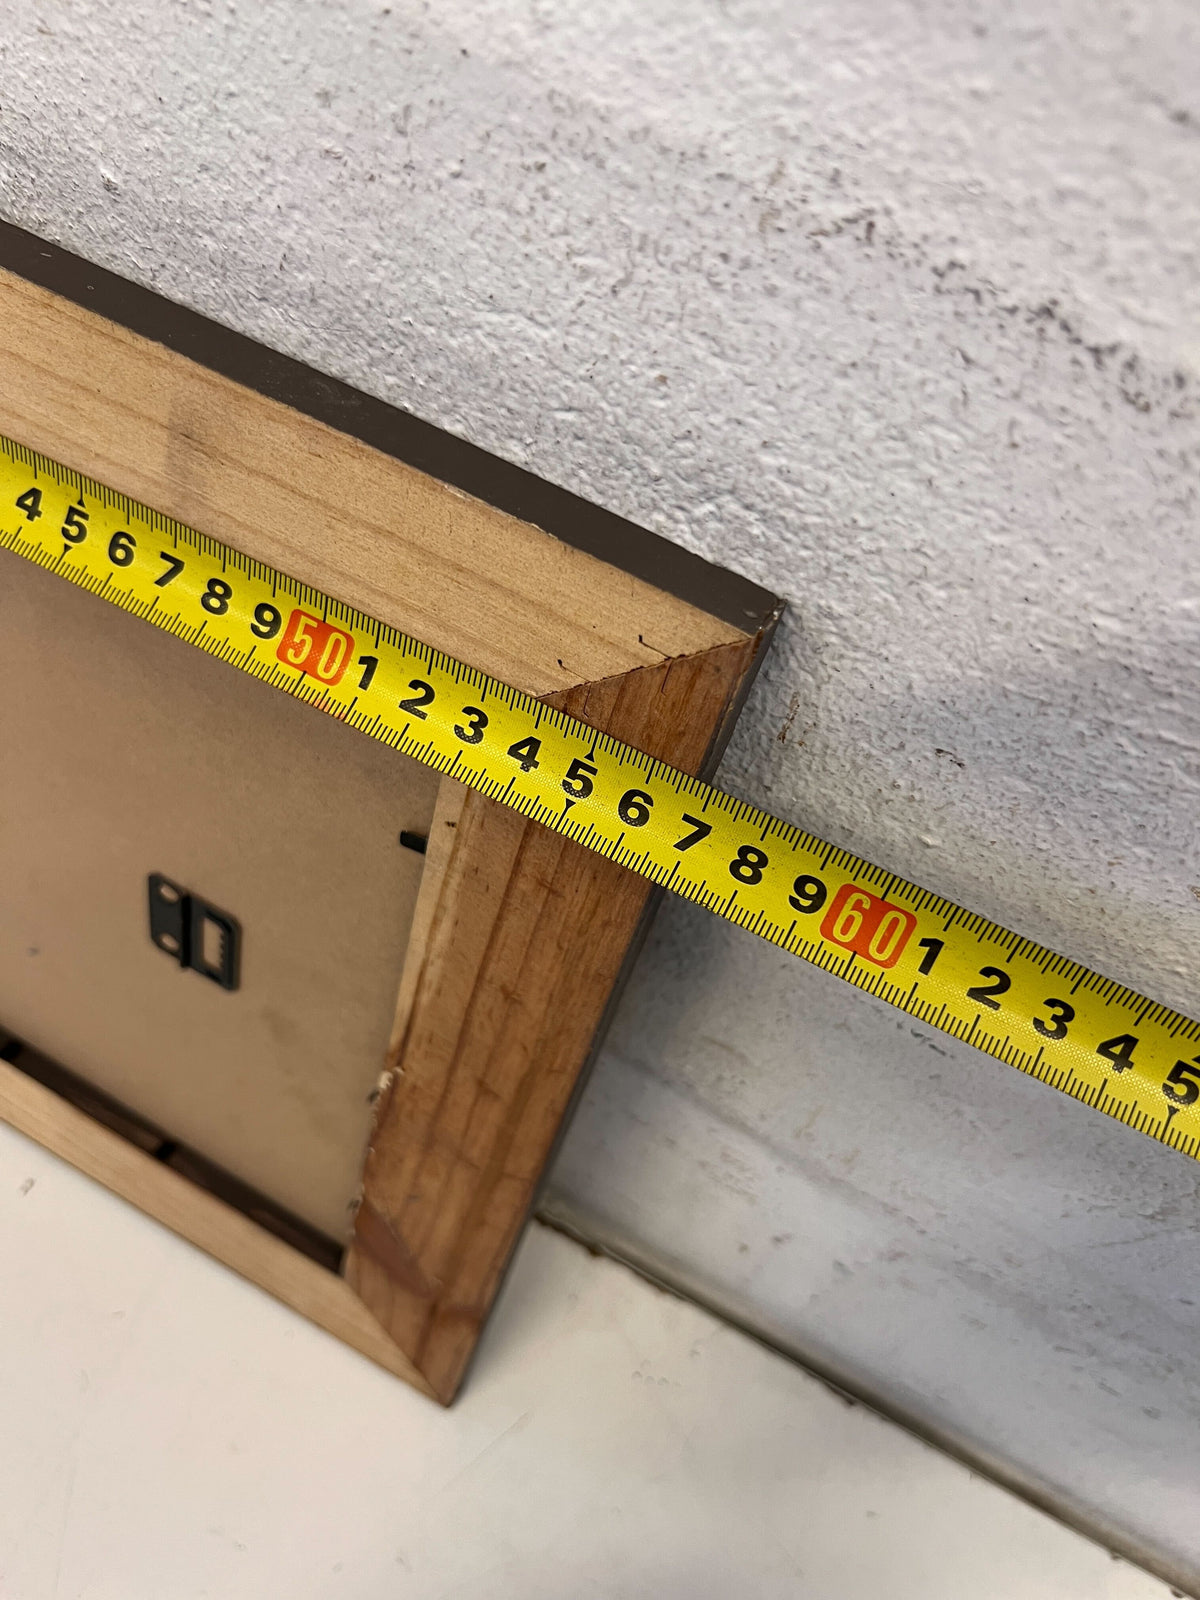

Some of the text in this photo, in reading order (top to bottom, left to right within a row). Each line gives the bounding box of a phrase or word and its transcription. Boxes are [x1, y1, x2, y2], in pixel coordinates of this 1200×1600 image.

[15, 487, 1200, 1106] 4 5 6 7 8 9 50 1 2 3 4 5 6 7 8 9 60 1 2 3 4 5
